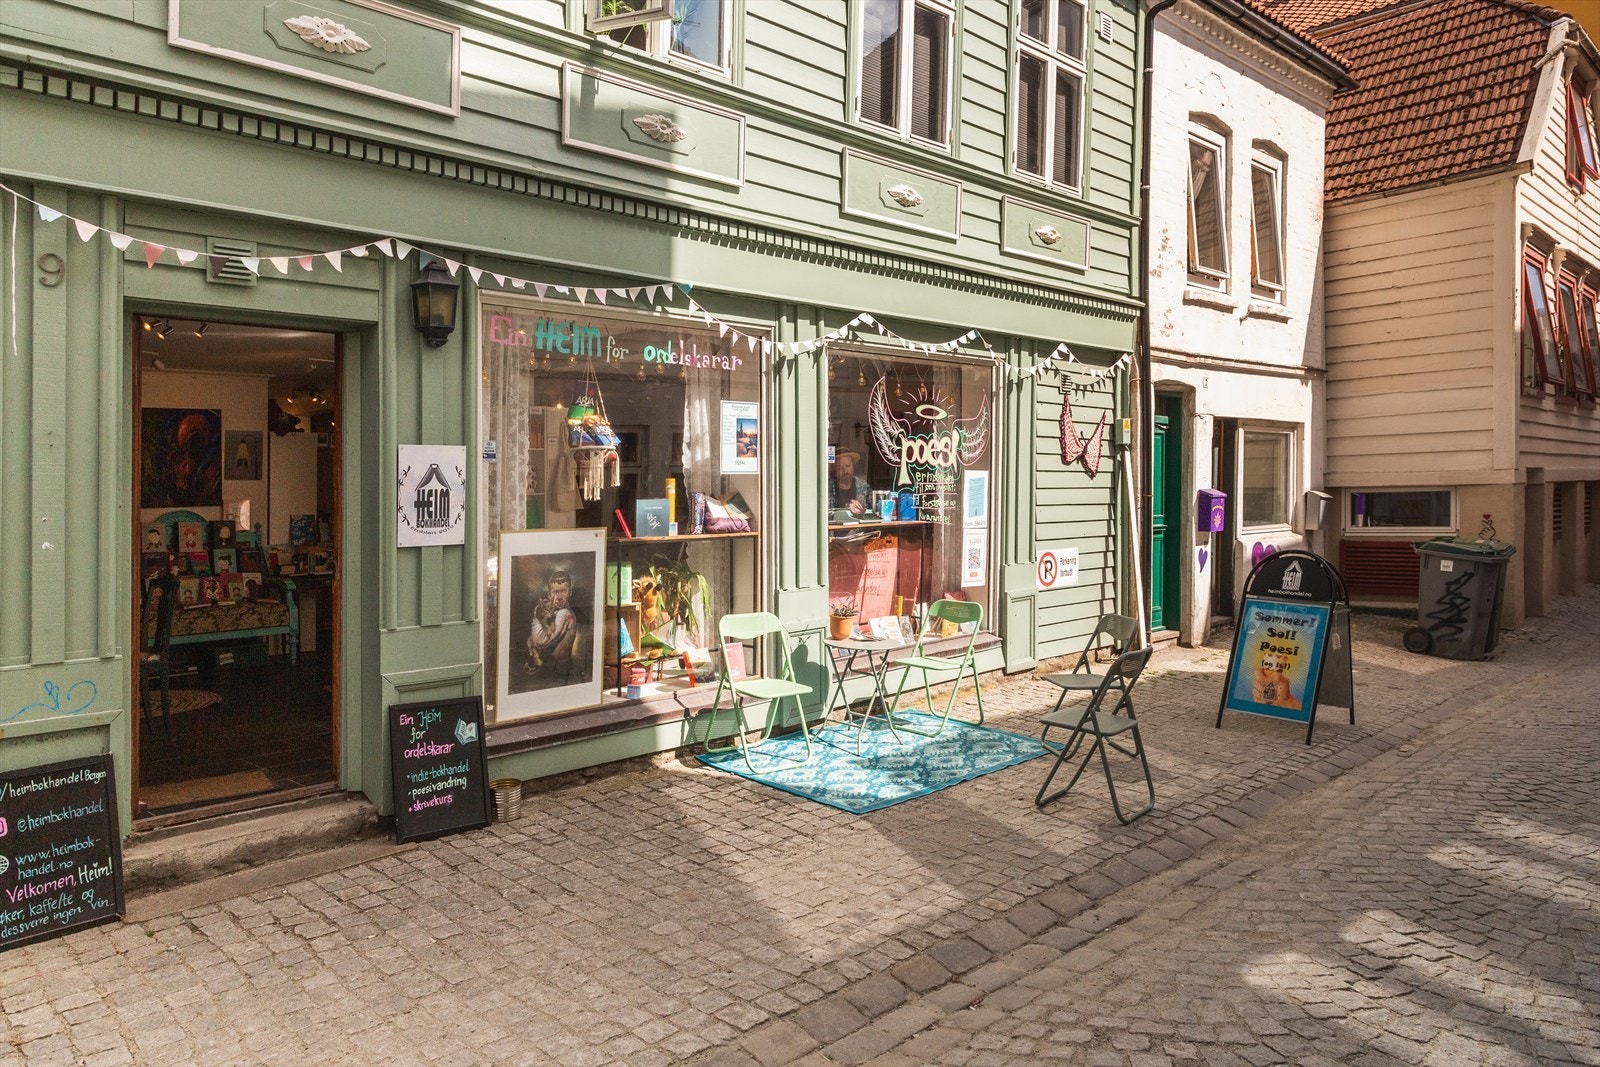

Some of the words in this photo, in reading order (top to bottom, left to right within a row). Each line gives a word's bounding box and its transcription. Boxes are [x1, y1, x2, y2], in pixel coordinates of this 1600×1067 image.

[37, 252, 65, 288] 9
[490, 315, 528, 347] Ein
[606, 335, 629, 363] for
[644, 340, 743, 371] ordelskarar
[414, 488, 450, 519] HEIM
[416, 518, 450, 529] BOKHANDEL
[1254, 611, 1317, 628] Sommer!
[1266, 627, 1298, 640] Sol!
[399, 713, 415, 726] Ein
[410, 727, 426, 744] for
[404, 741, 455, 759] ordelskarar
[411, 759, 471, 782] indie-bokhandel
[412, 776, 467, 800] poesivandring
[413, 794, 454, 812] skrivekurs
[15, 836, 101, 866] www.heimbok-
[6, 874, 77, 904] Velkomen,
[78, 856, 113, 884] Heim!
[18, 860, 73, 880] handel.no
[82, 888, 95, 903] og
[1, 915, 49, 938] dessverre
[53, 906, 83, 924] ingen
